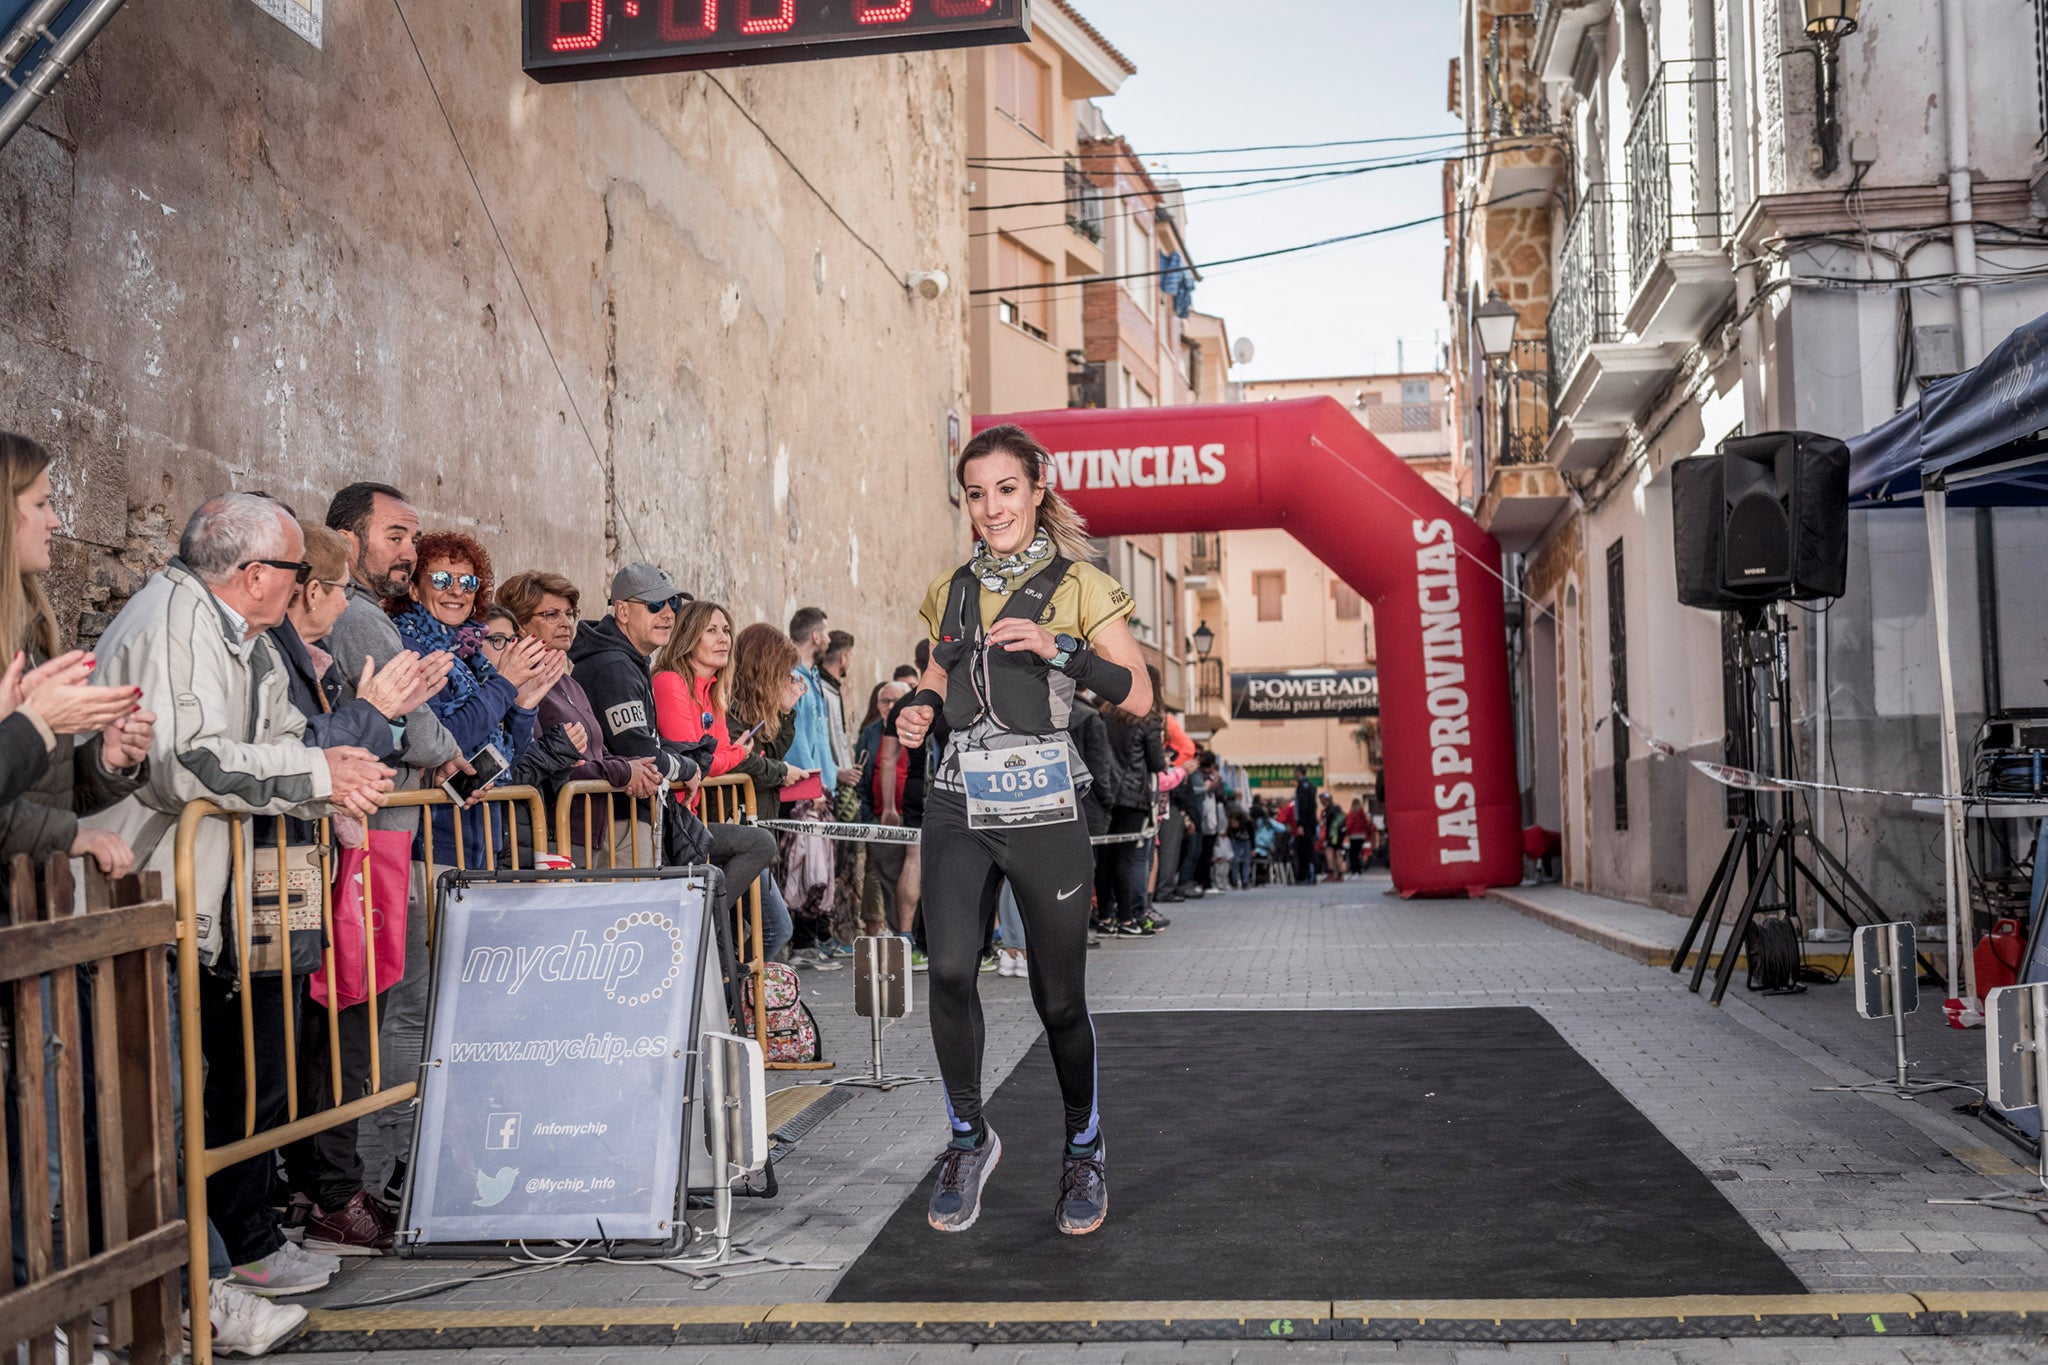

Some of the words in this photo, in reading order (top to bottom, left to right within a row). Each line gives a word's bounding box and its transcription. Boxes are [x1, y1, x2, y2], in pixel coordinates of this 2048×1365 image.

[1412, 518, 1473, 777] PROVINCIAS
[1249, 698, 1291, 712] bebida
[1293, 700, 1320, 714] para
[1323, 696, 1380, 712] deportist
[987, 768, 1049, 793] 1036
[1434, 781, 1481, 865] LAS
[461, 929, 644, 995] mychip
[451, 1032, 668, 1067] www.mychip.es
[532, 1121, 607, 1136] /infomychip
[525, 1177, 616, 1194] @Mychip_Info
